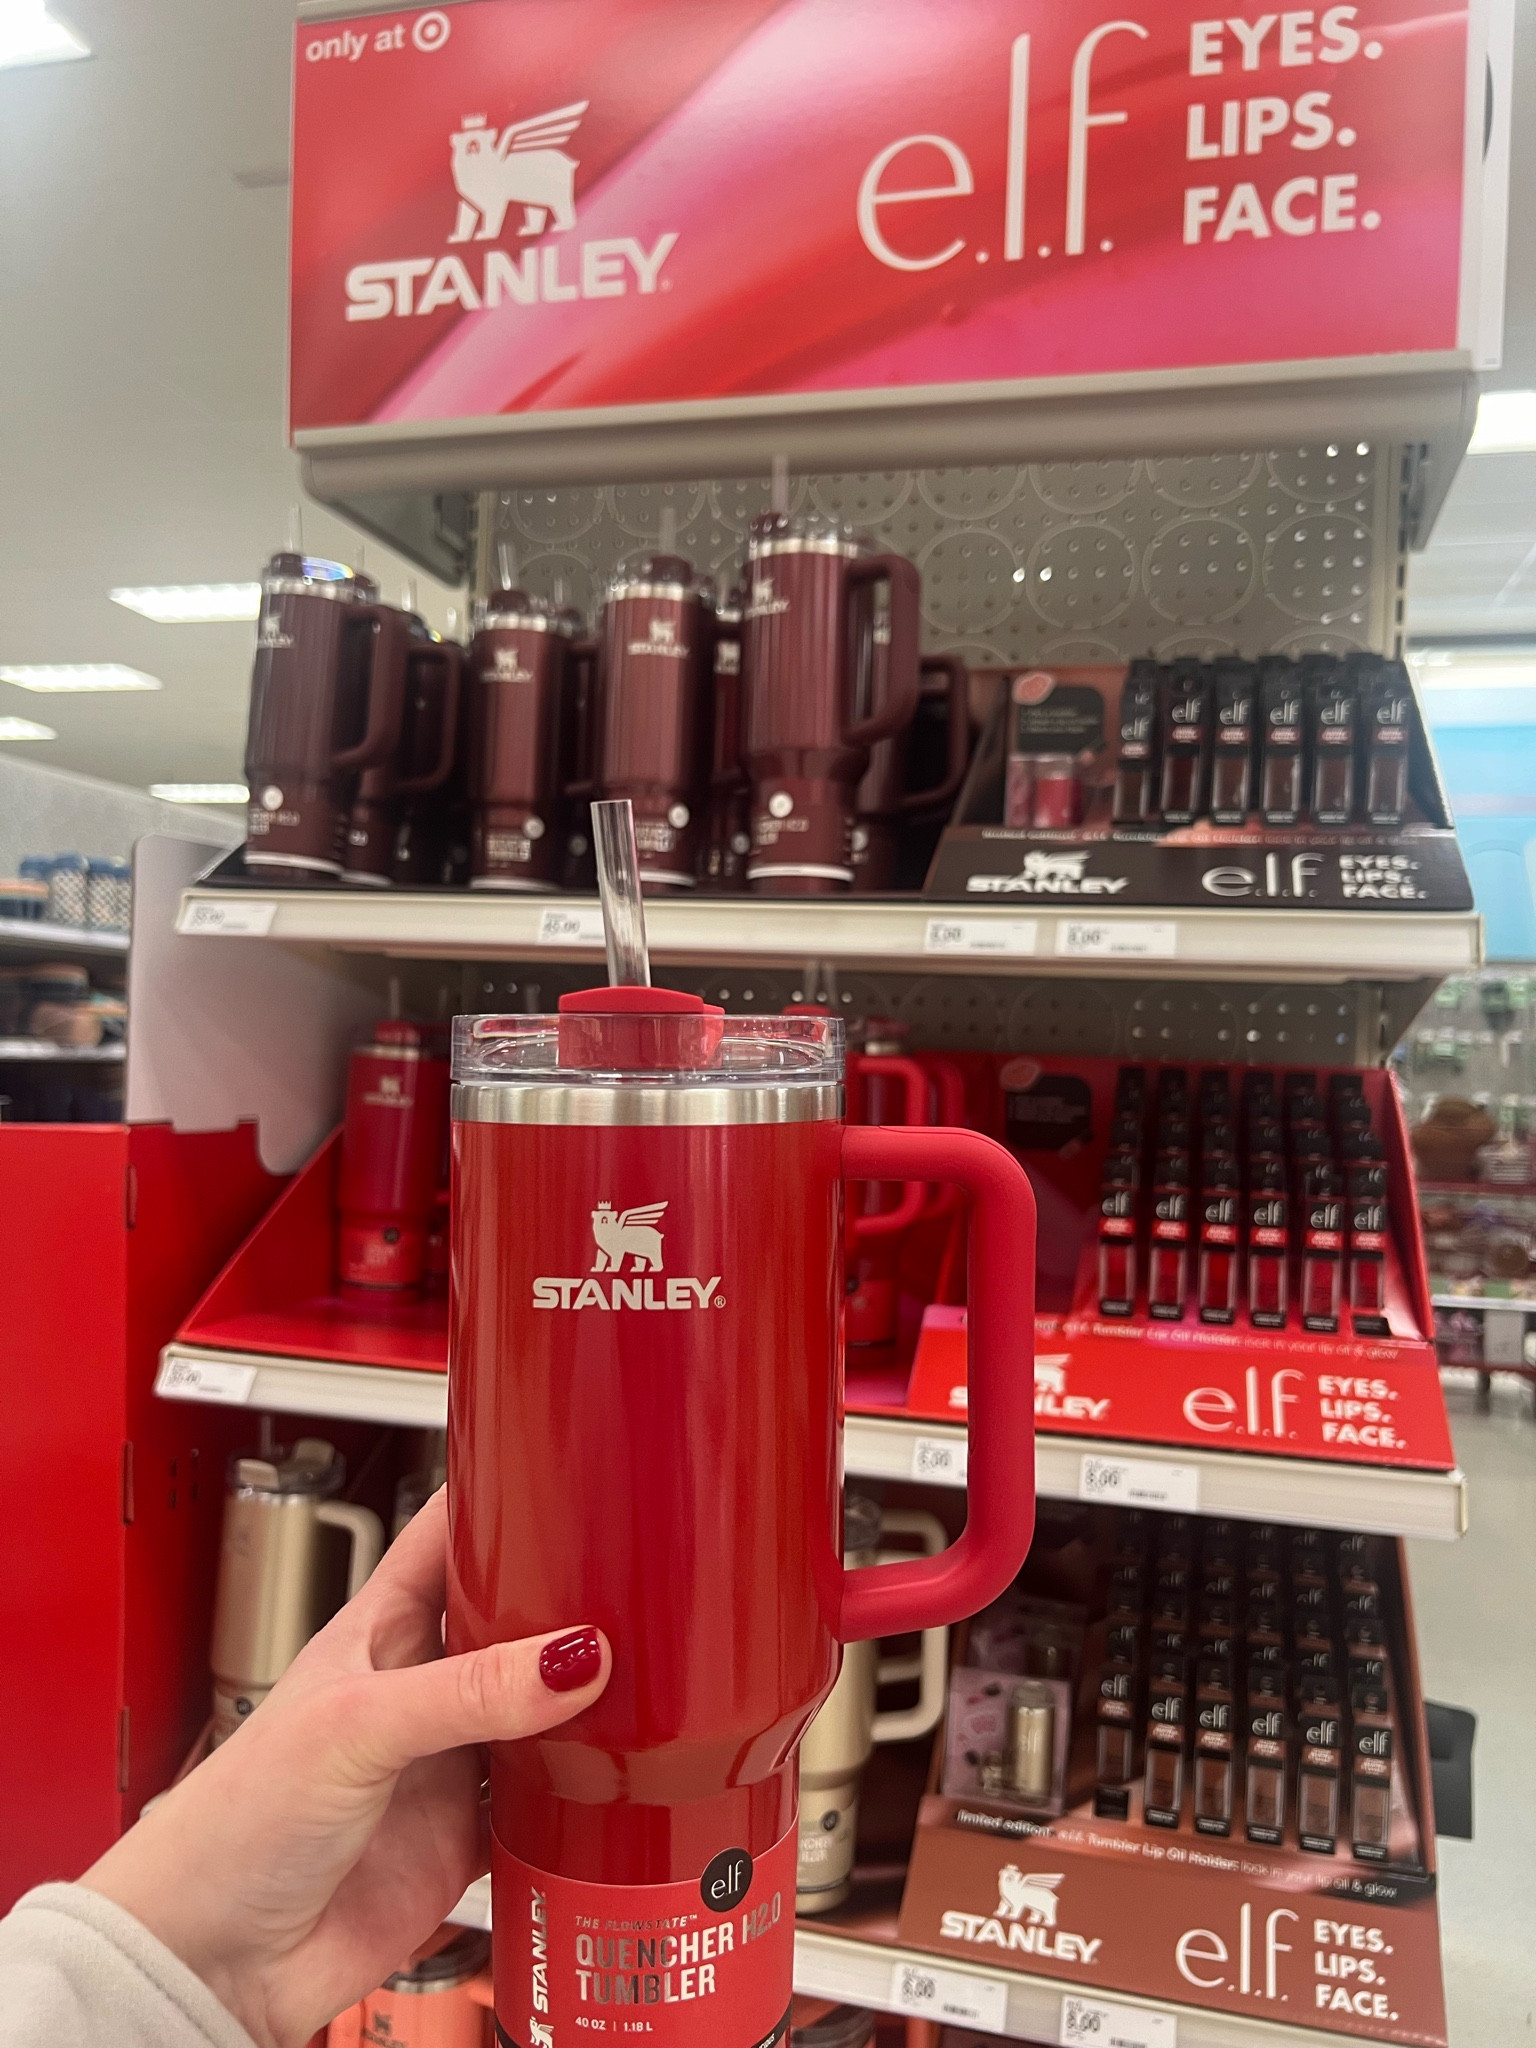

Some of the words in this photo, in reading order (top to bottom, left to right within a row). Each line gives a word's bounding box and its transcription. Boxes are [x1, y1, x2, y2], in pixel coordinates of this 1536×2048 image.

[305, 30, 368, 62] only
[374, 24, 405, 51] at
[1189, 6, 1384, 76] EYES.
[1186, 91, 1357, 161] LIPS.
[857, 21, 1149, 272] e.l.f.
[1183, 174, 1382, 245] FACE.
[1201, 852, 1326, 898] e.l.f.
[1339, 854, 1422, 869] EYES.
[1341, 868, 1412, 884] LIPS.
[966, 874, 1131, 894] STANLEY
[1343, 883, 1428, 899] FACE.
[1183, 1366, 1307, 1440] e.l.f.
[1318, 1374, 1399, 1400] EYES.
[1320, 1398, 1393, 1424] LIPS.
[1322, 1421, 1407, 1449] FACE.
[575, 1915, 600, 1929] THE
[575, 1921, 734, 1969] QUENCHER
[742, 1891, 781, 1945] H2.0
[940, 1910, 1103, 1964] STANLEY
[1314, 1918, 1394, 1954] EYES.
[1175, 1902, 1299, 2001] e.l.f.
[1315, 1951, 1386, 1986] LIPS.
[575, 1963, 716, 2005] TUMBLER
[1315, 1983, 1399, 2021] FACE.
[575, 2016, 589, 2028] 40
[591, 2019, 606, 2031] OZ
[623, 2021, 644, 2033] 1.18
[646, 2021, 654, 2032] L
